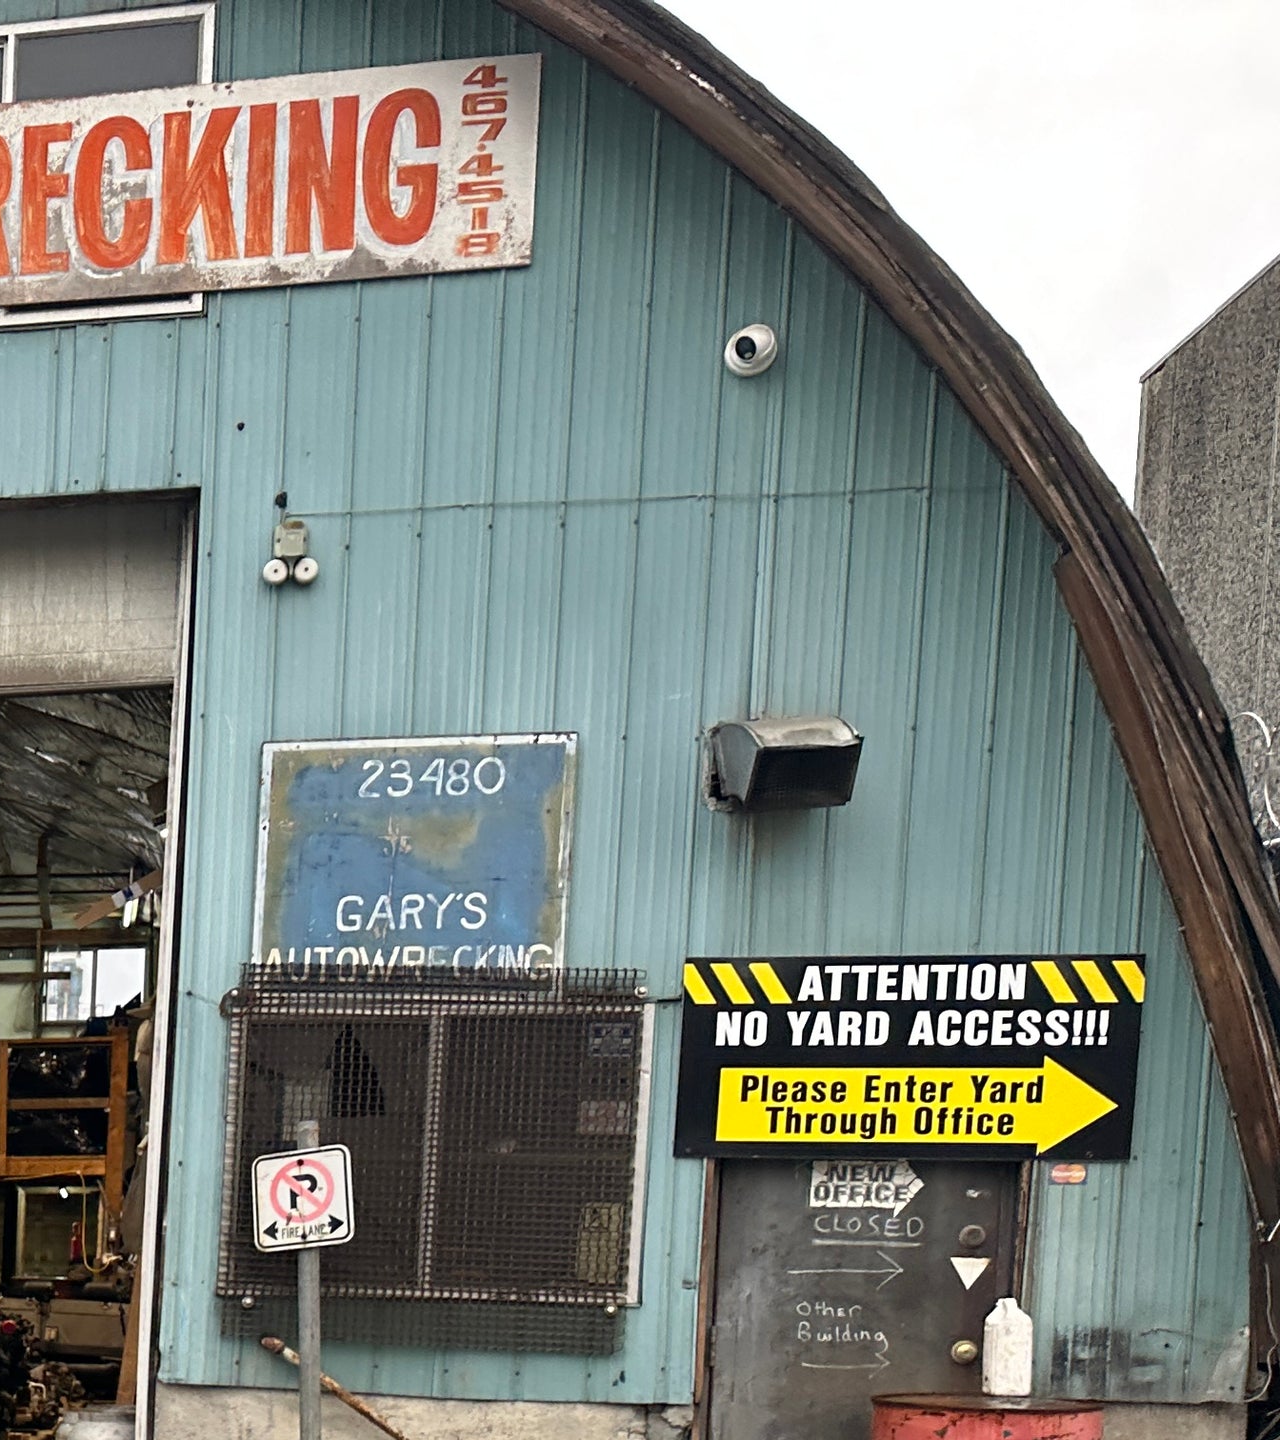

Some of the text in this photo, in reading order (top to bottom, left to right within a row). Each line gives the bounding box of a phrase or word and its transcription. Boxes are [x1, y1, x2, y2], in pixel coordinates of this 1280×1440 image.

[357, 756, 507, 798] 23480
[335, 892, 488, 932] GARY'S
[797, 962, 1028, 1002] ATTENTION
[715, 1009, 1110, 1047] NO YARD ACCESS!!!
[740, 1074, 1044, 1104] Please Enter Yard
[765, 1106, 1015, 1140] Through Office
[828, 1163, 894, 1182] NEW
[814, 1180, 909, 1203] OFFICE
[281, 1226, 300, 1239] FIRE
[814, 1214, 924, 1238] CLOSED
[796, 1301, 862, 1318] Other
[797, 1321, 889, 1353] Building
